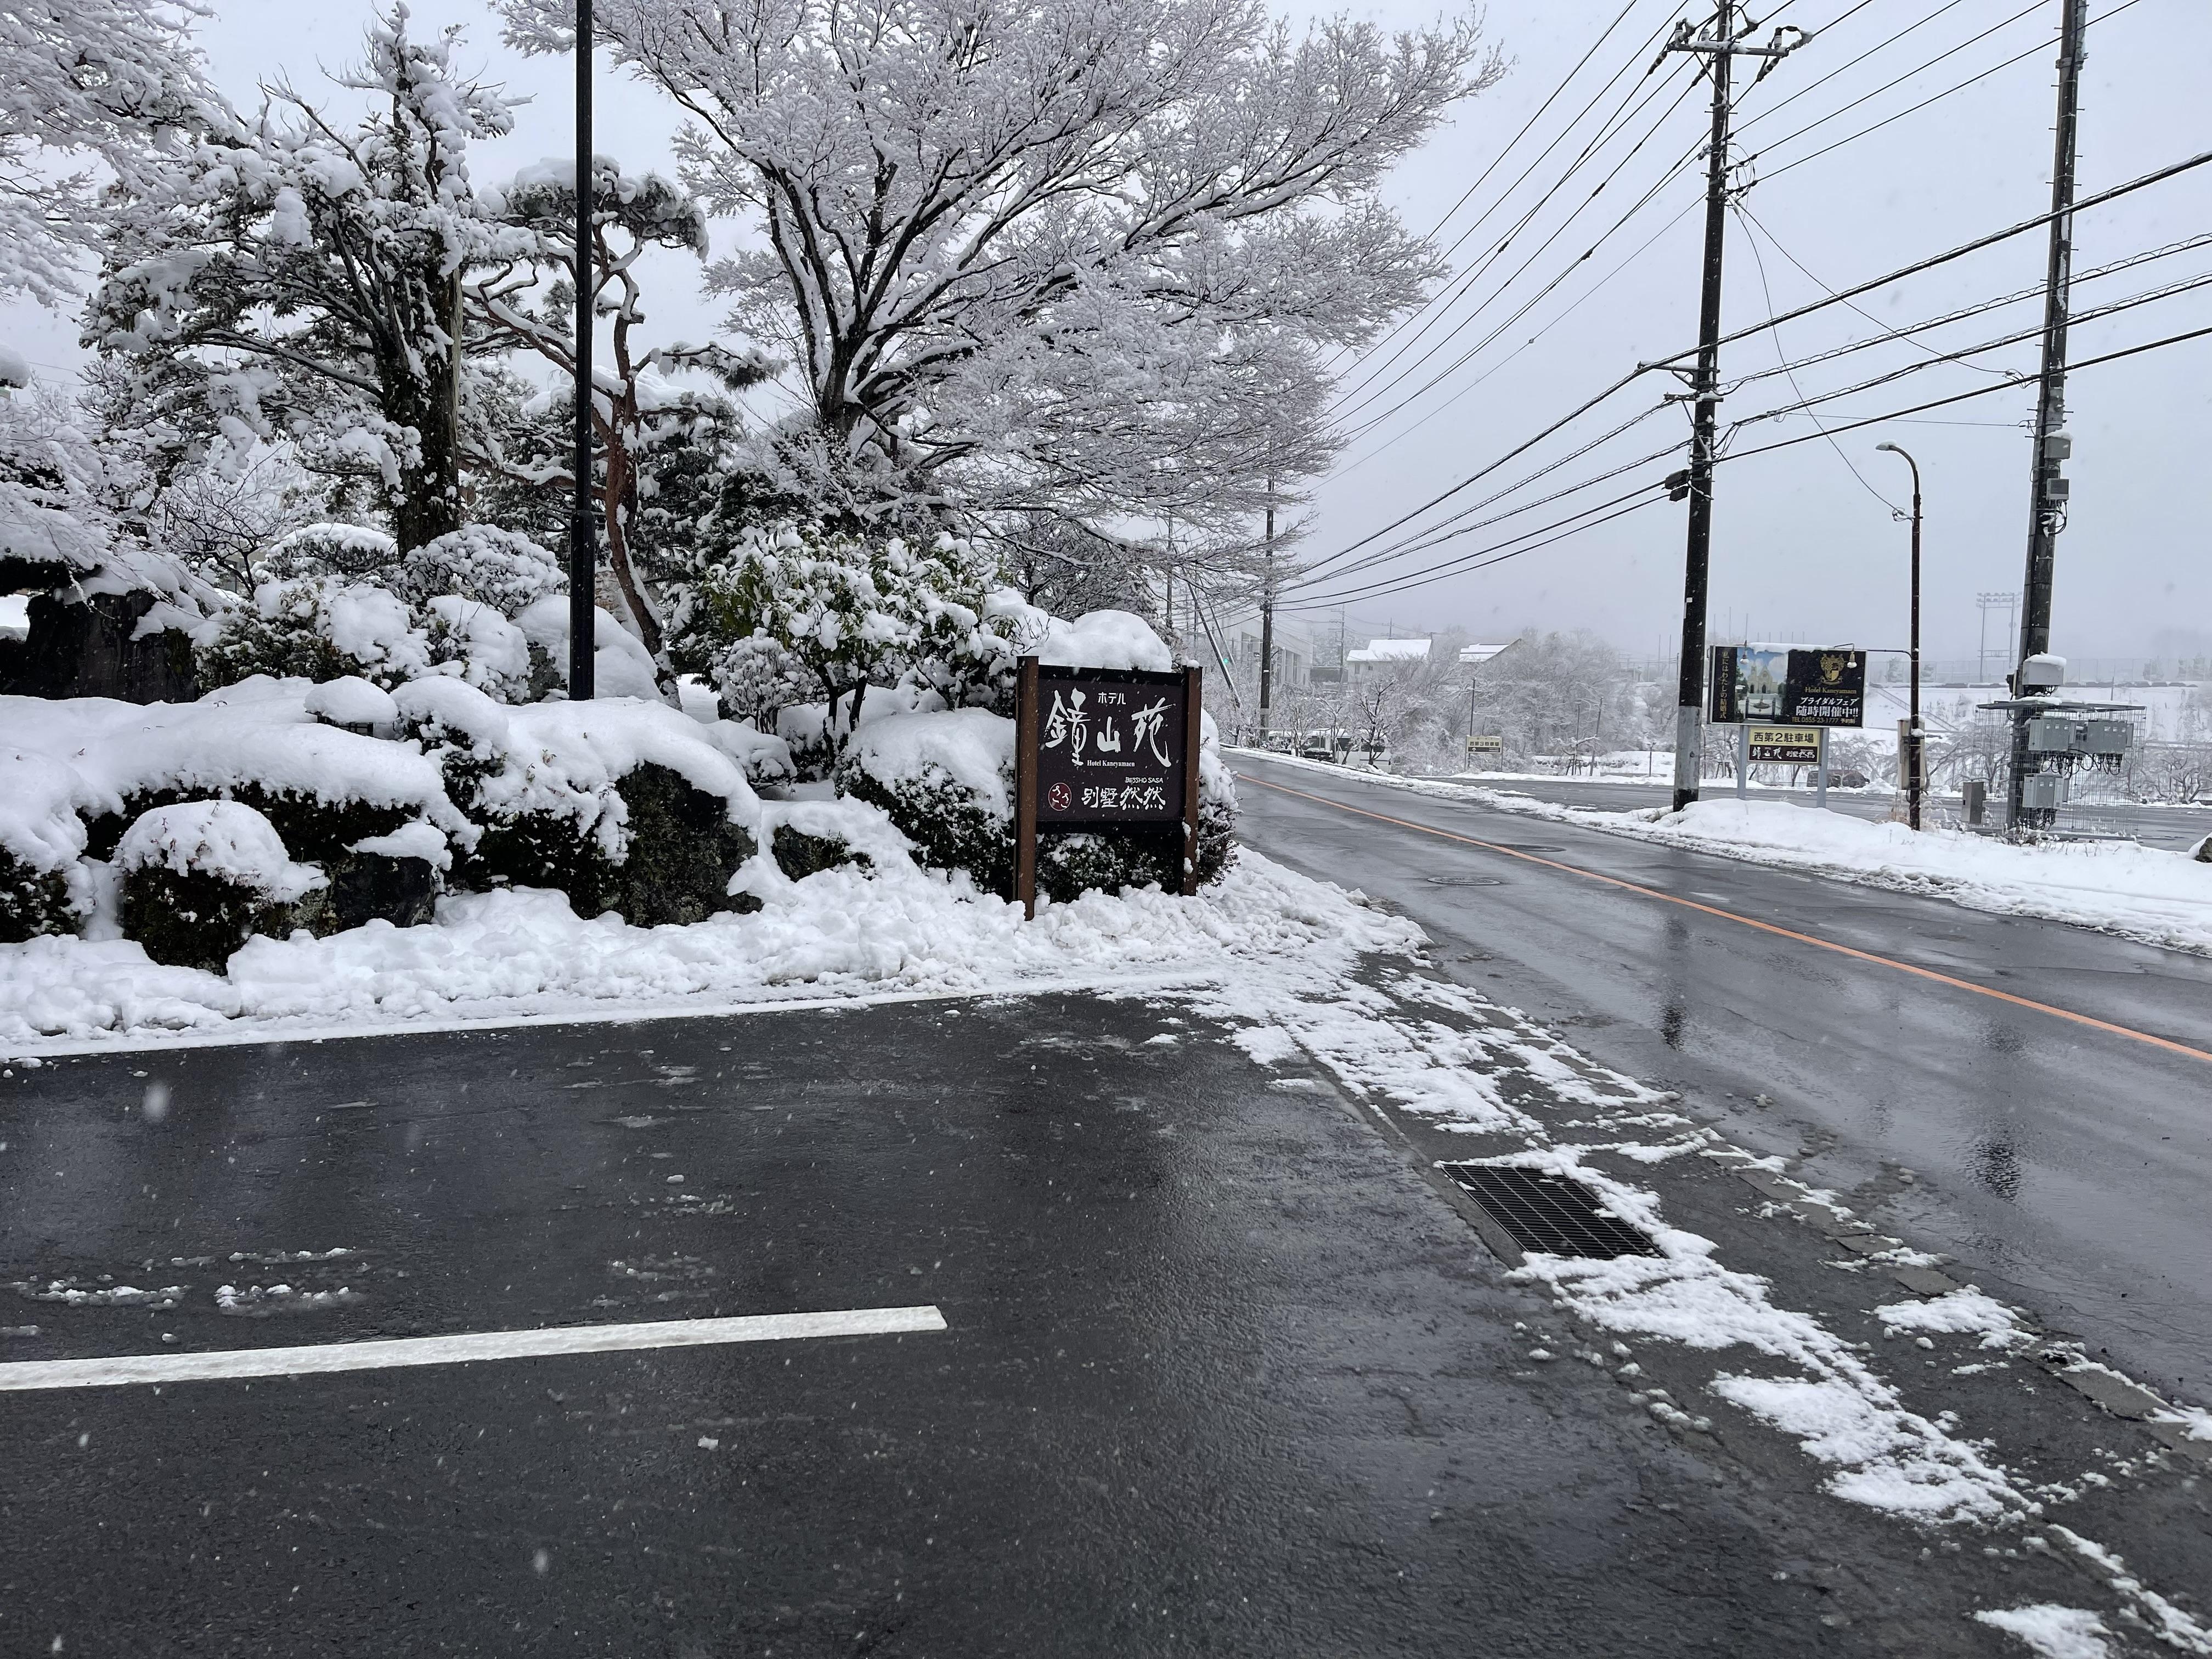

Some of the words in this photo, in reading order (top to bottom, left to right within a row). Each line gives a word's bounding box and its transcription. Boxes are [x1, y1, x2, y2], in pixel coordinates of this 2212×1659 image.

[1098, 692, 1126, 705] ホテル
[1800, 697, 1860, 706] ブライダルフェア
[1754, 732, 1814, 743] 西第2駐車場
[1081, 786, 1166, 810] 別墅然然
